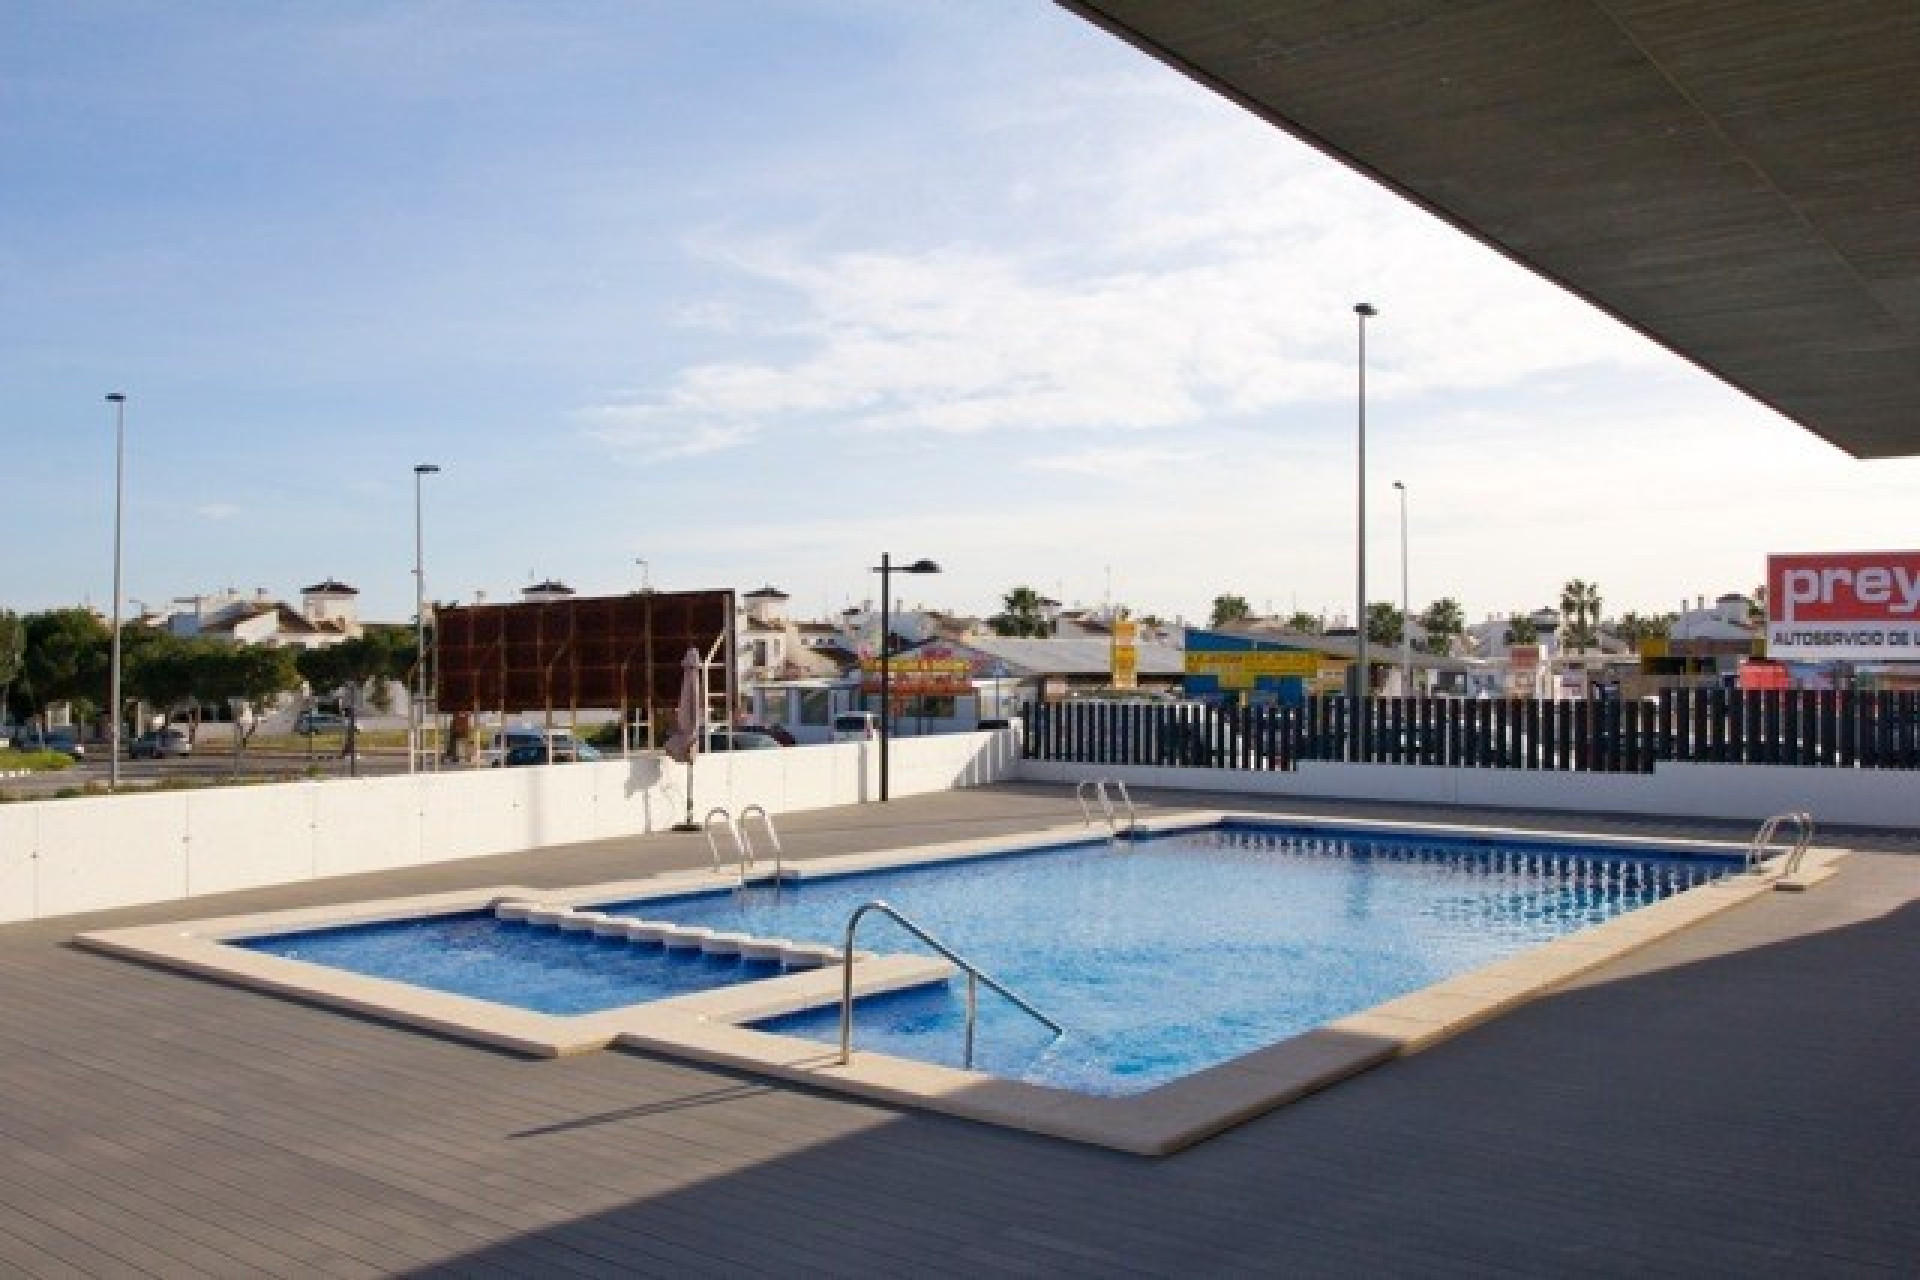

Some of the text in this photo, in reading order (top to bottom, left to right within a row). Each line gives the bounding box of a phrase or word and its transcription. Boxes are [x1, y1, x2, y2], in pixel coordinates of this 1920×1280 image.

[1784, 567, 1920, 623] prey
[1773, 630, 1885, 646] AUTOSERVICIO
[1889, 630, 1909, 646] DE
